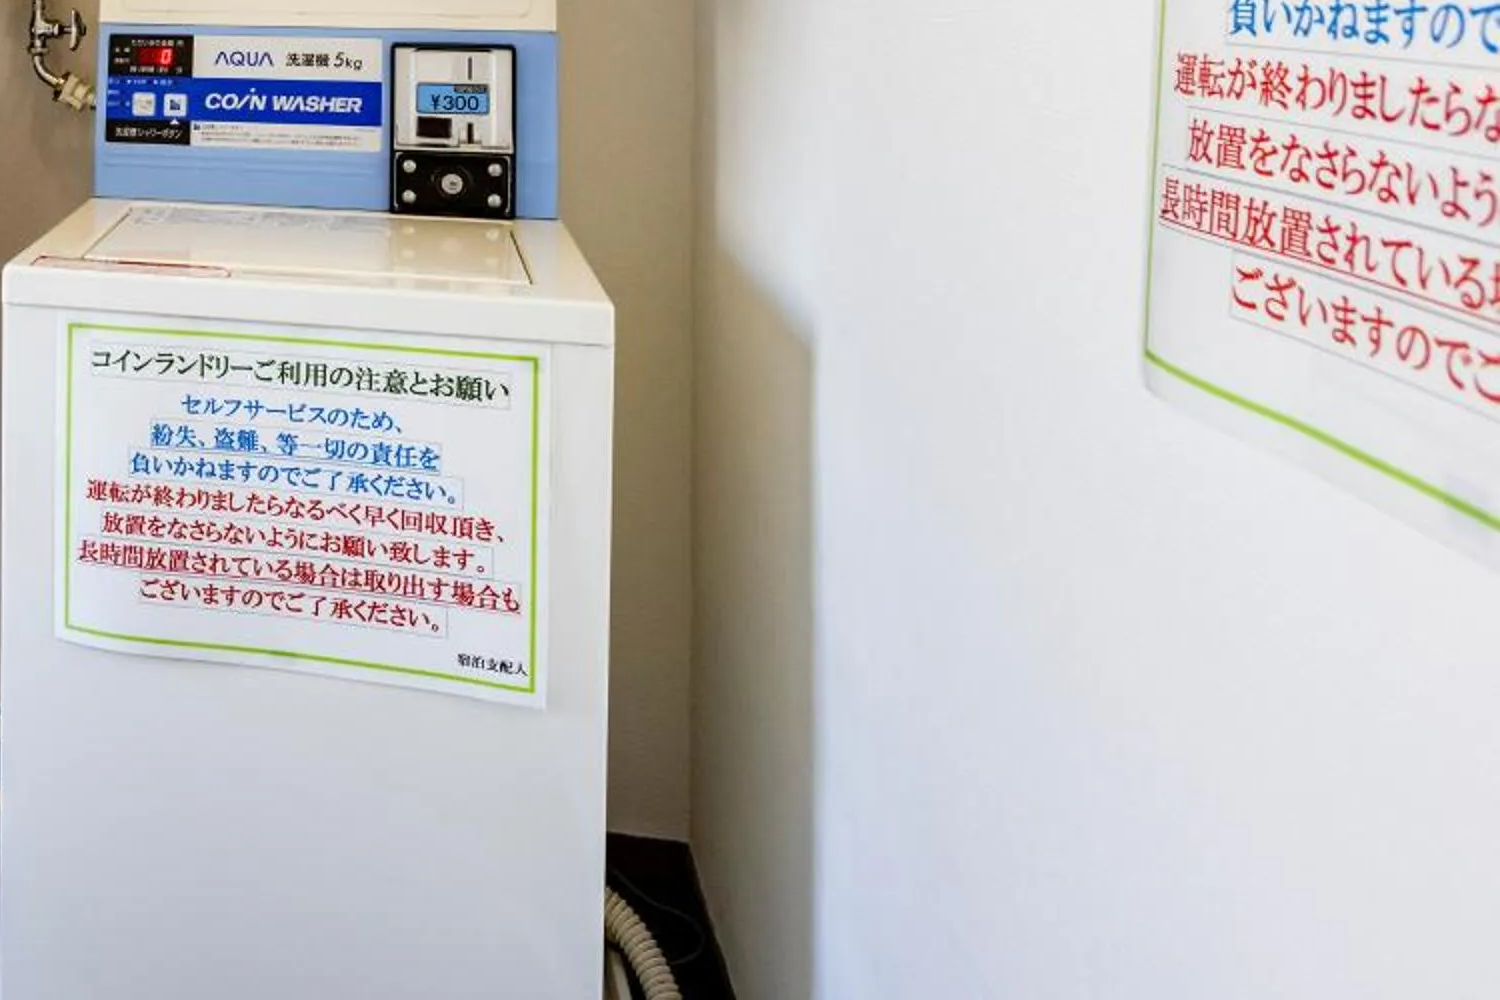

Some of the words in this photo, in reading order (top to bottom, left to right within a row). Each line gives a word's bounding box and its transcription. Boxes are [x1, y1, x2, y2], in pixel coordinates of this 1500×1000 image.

[161, 49, 172, 65] 0
[214, 51, 274, 67] AQUA
[285, 52, 330, 67] 洗濯機
[333, 53, 363, 71] 5kg
[205, 88, 267, 111] COIN
[272, 94, 363, 113] WASHER
[431, 94, 480, 111] ¥300
[1173, 50, 1500, 143] 運転が終わりましたらな
[1187, 118, 1498, 228] 放置をなさらないよう
[91, 349, 510, 402] コインランドリーご利用の注意とお願い
[181, 393, 402, 433] セルフサービスのため、
[151, 423, 441, 470] 紛失、盗難、等一切の責任を
[131, 451, 456, 504] 負いかねますのでご了承ください。
[86, 479, 504, 543] 運転が終わりましたらなるべく早く回収頂き、
[101, 511, 485, 574] 放置をなさらないようにお願い致します。
[78, 539, 520, 614] 長時間放置されている場合は取り出す場合も
[139, 578, 440, 633] ございますのでご了承ください。
[457, 653, 529, 677] 宿泊支配人
